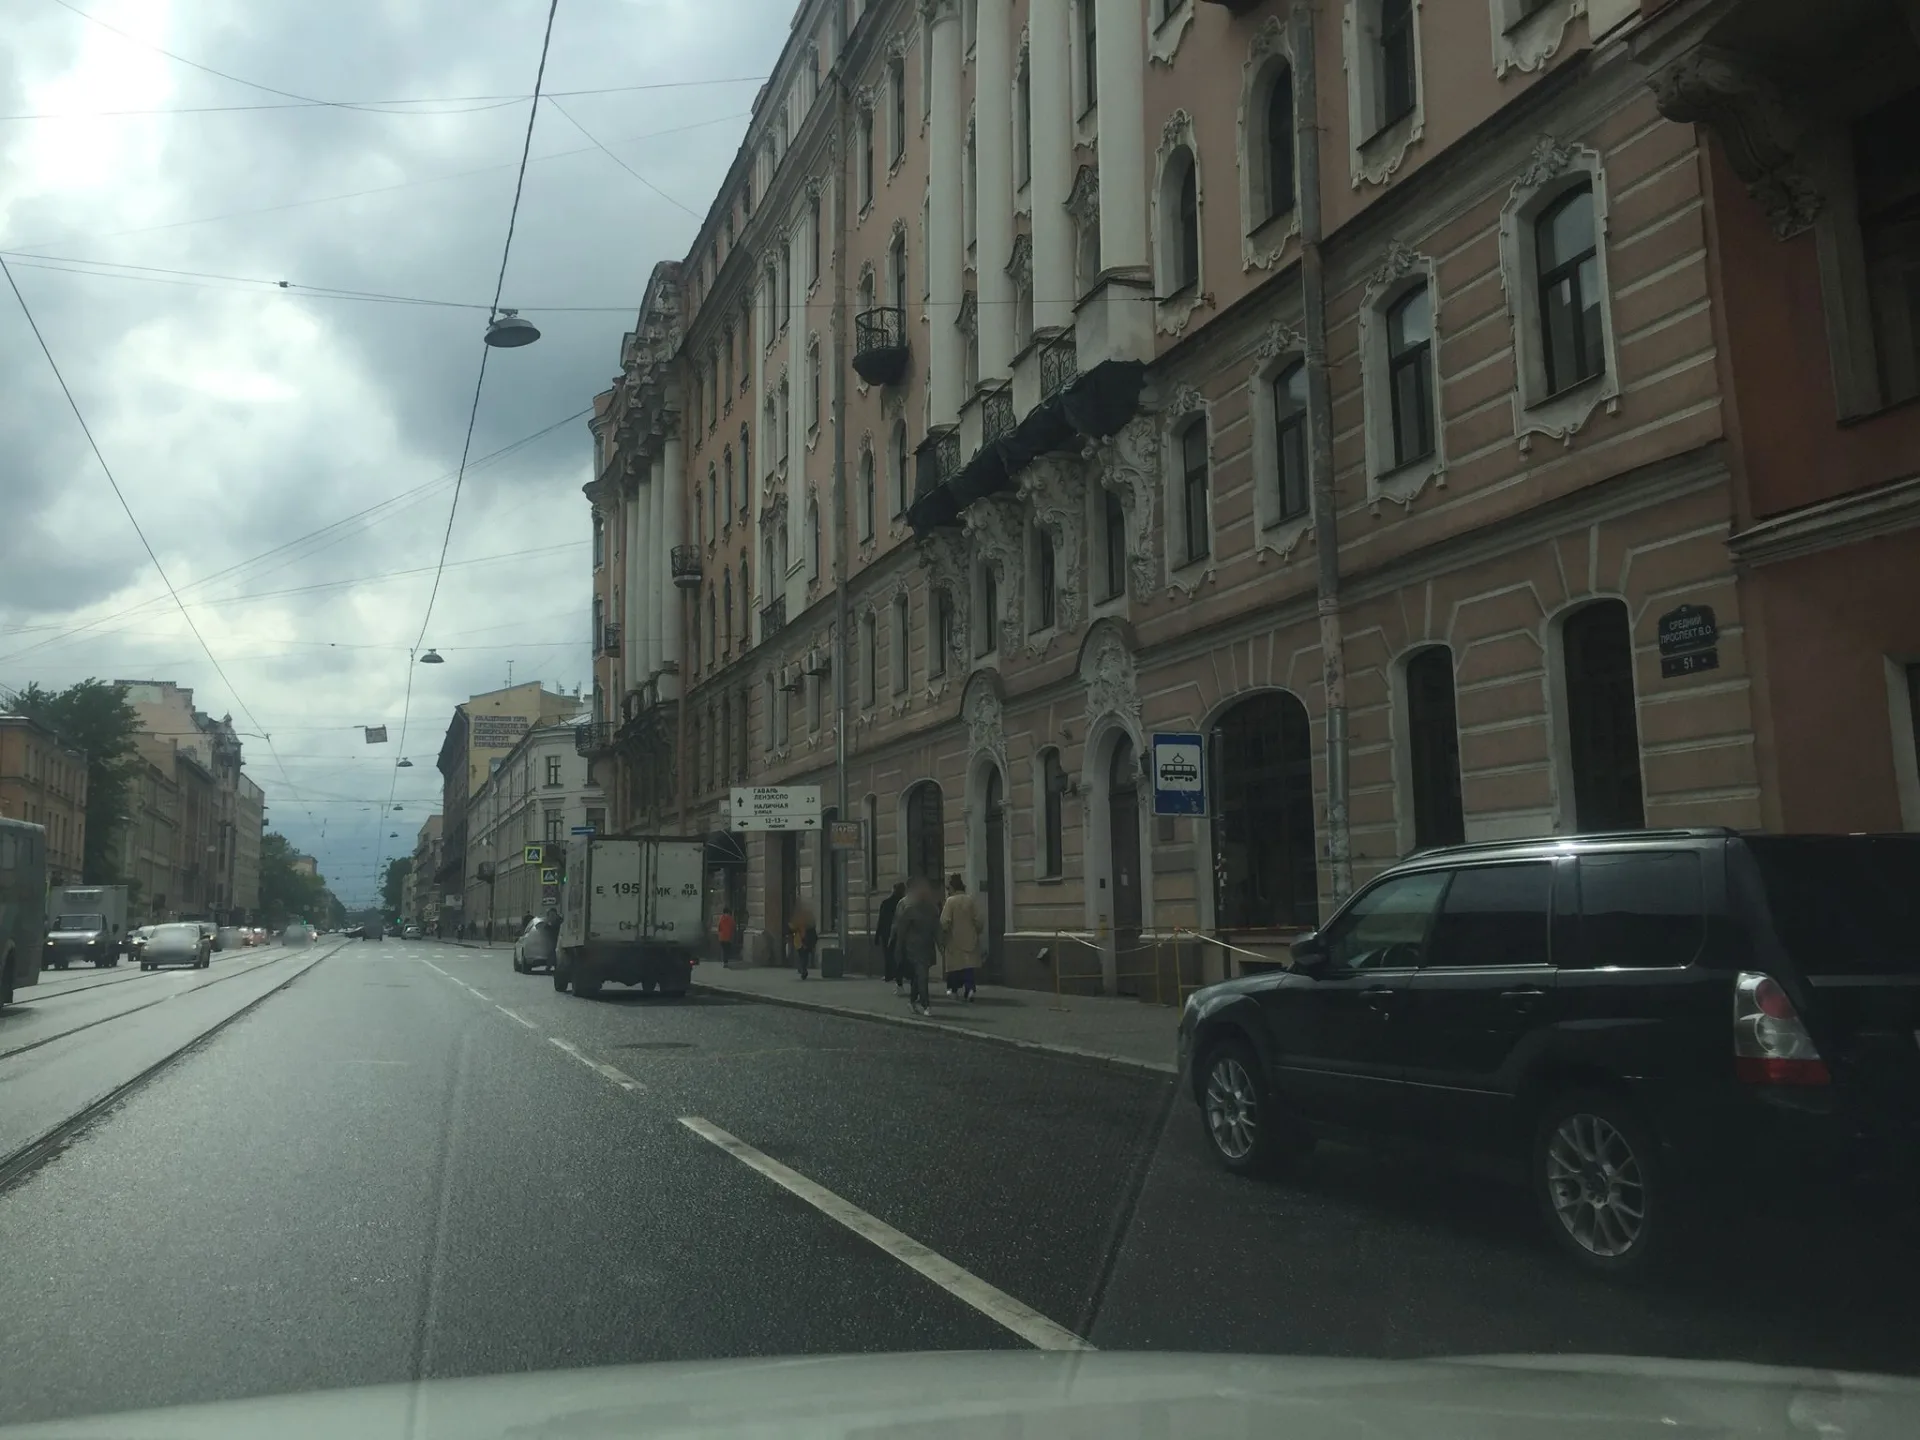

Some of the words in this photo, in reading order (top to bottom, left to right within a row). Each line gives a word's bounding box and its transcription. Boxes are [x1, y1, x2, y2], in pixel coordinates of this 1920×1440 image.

[1669, 614, 1702, 631] СРЕДНИЙ
[1660, 628, 1697, 644] ПРОСПЕКТ
[1683, 656, 1694, 669] 51
[612, 882, 640, 894] 195
